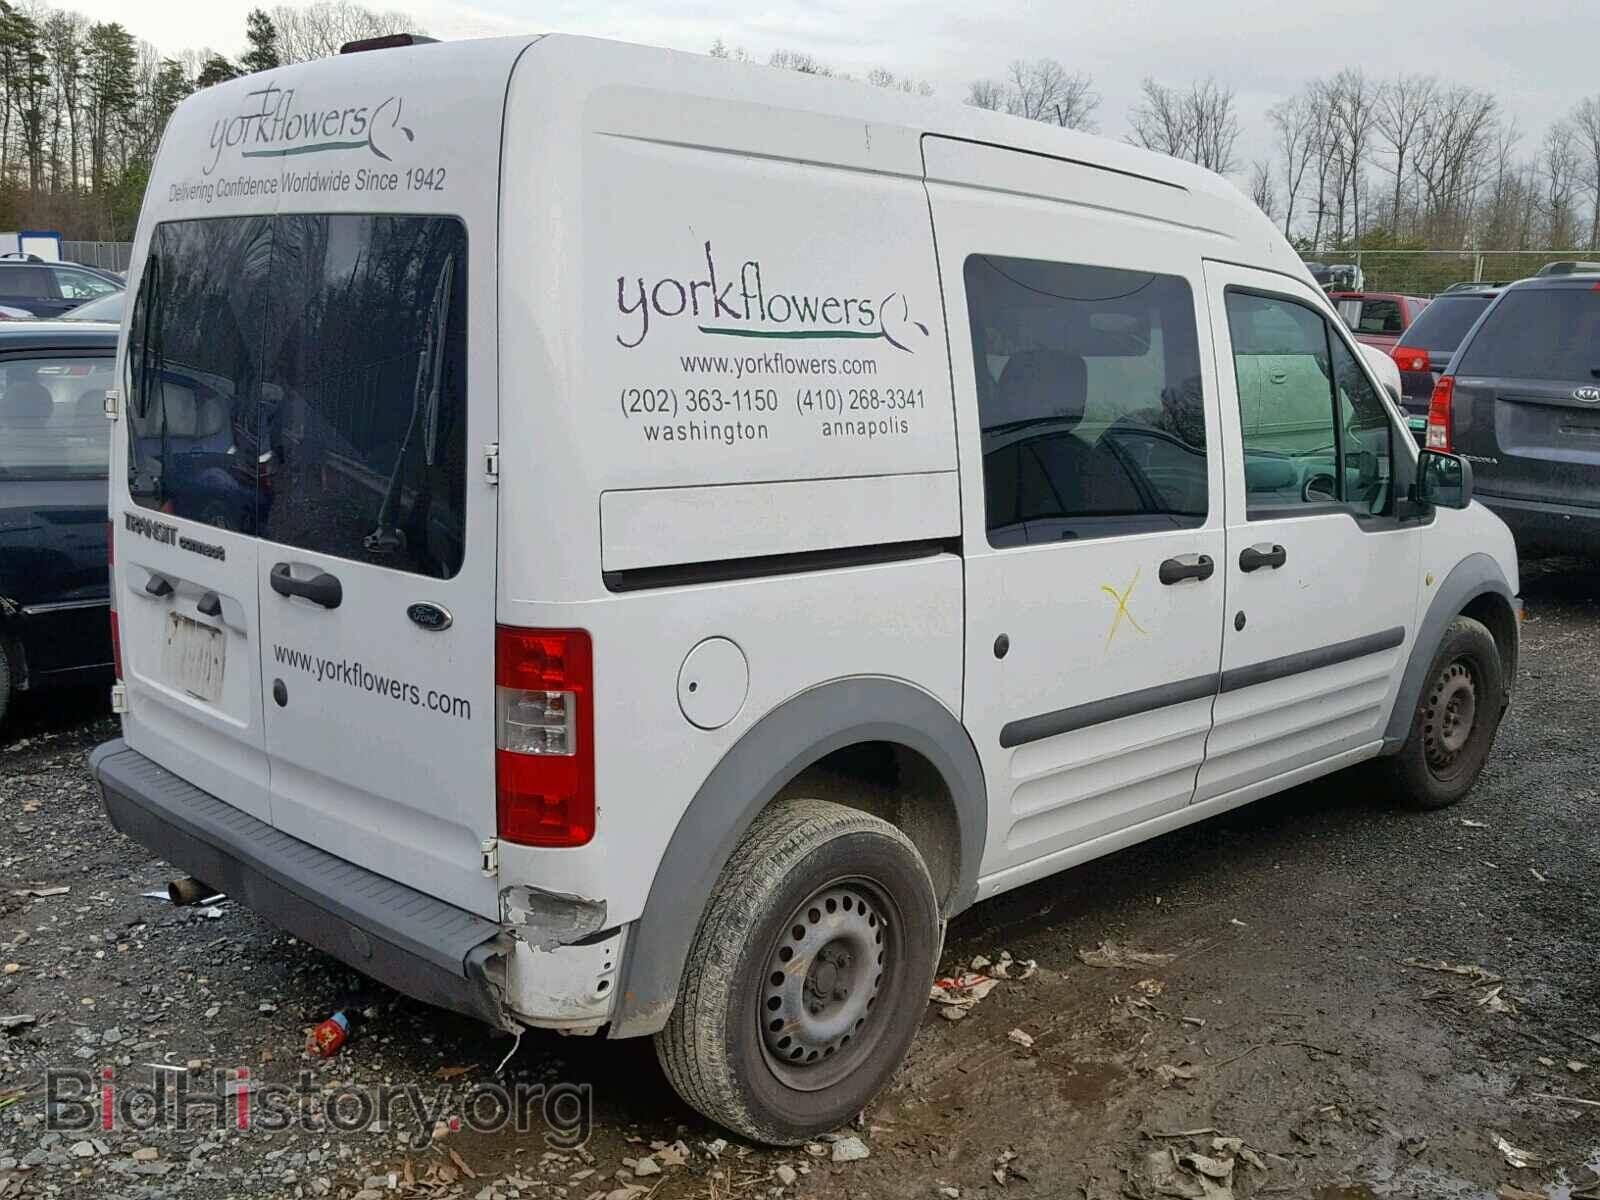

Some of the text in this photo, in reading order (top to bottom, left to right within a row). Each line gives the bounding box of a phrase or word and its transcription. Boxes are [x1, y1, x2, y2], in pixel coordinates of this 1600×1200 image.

[203, 81, 369, 176] yorkflowers
[169, 167, 446, 204] Delivering Confidence Worldwide Since 1942
[616, 240, 876, 348] yorkflowers
[680, 352, 878, 379] www.yorkflowers.com
[620, 388, 778, 418] (202) 363-1150
[796, 388, 925, 416] (410) 268-3341
[1578, 389, 1599, 399] KIA
[643, 420, 769, 446] washington
[821, 416, 910, 443] annapolis
[124, 511, 178, 547] TRANSIT
[273, 644, 472, 721] www.yorkflowers.com
